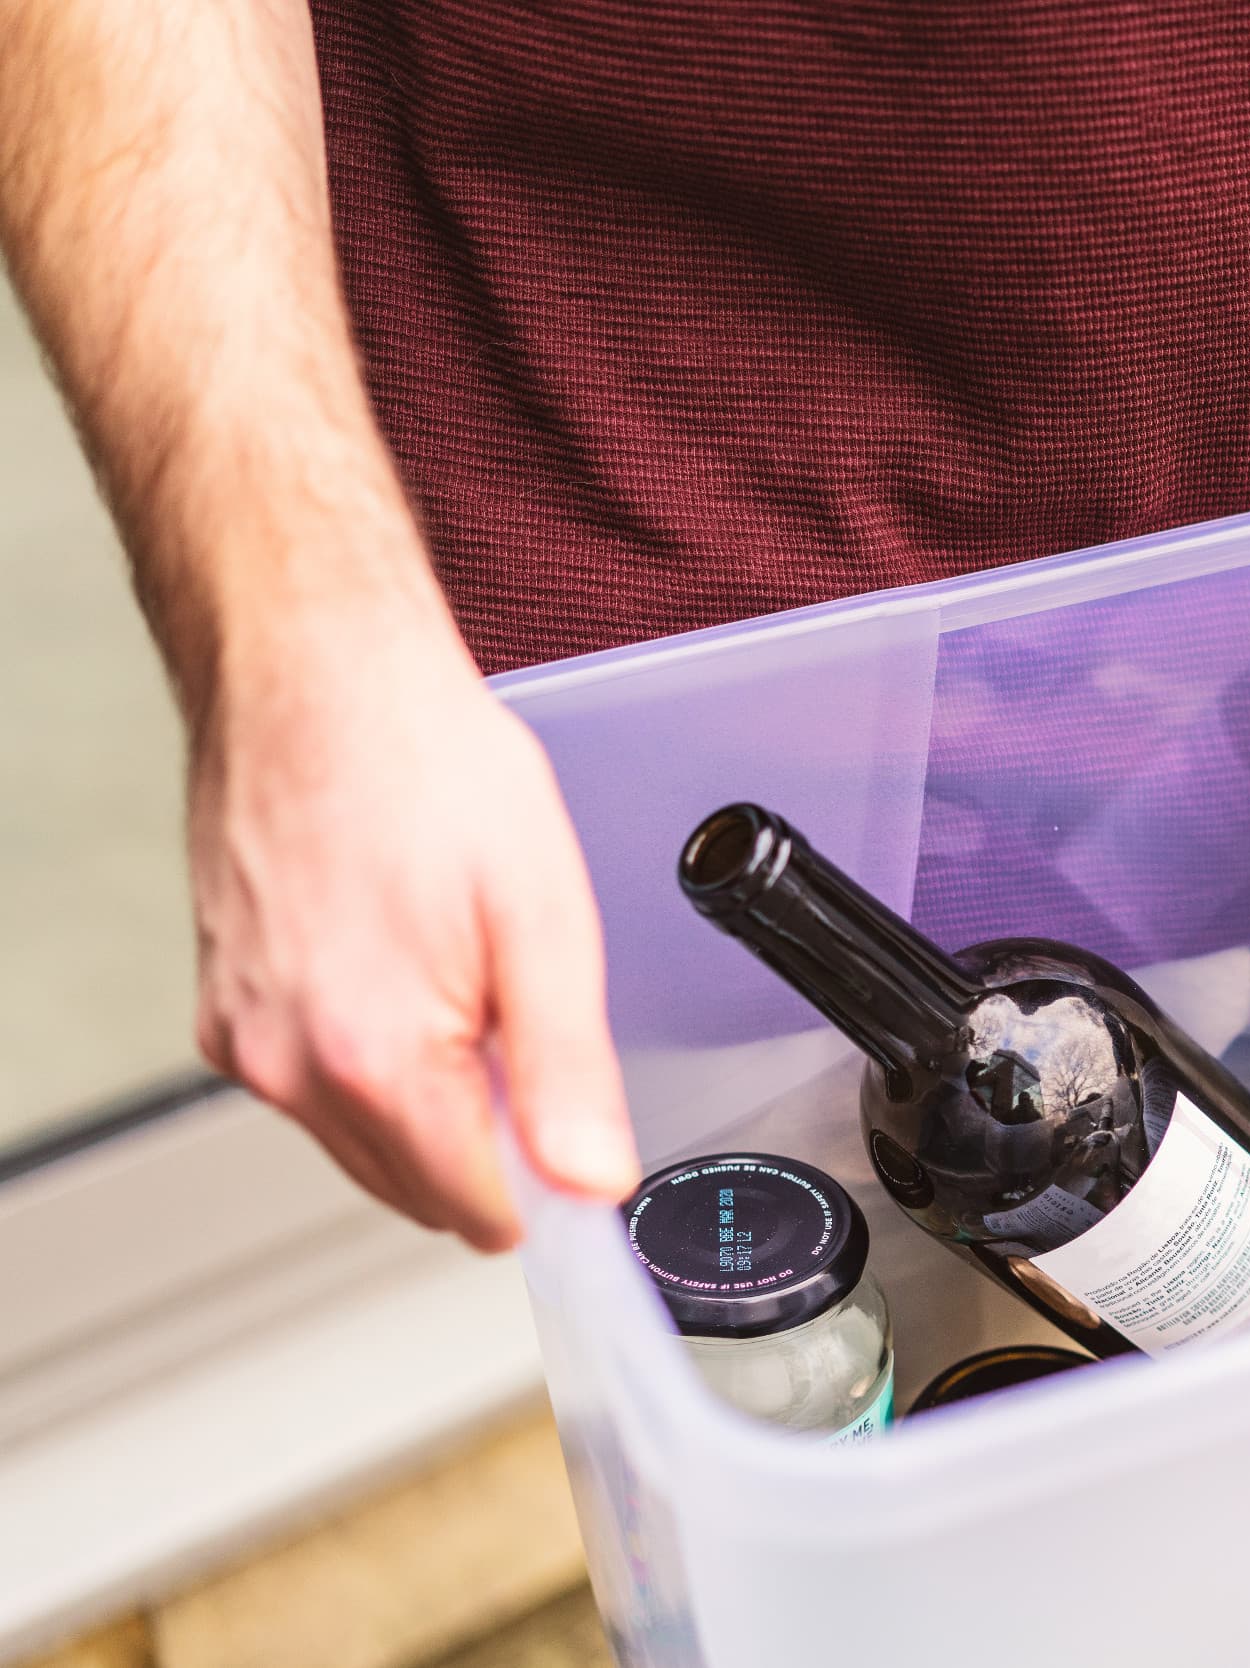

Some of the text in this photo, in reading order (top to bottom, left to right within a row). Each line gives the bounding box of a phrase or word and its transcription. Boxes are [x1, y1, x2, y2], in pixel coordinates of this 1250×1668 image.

[701, 1164, 740, 1175] PUSHED
[759, 1166, 779, 1175] CAN
[670, 1171, 699, 1185] DOWN
[780, 1171, 812, 1189] BUTTON
[719, 1188, 734, 1207] 2020
[810, 1188, 829, 1209] SAFETY
[633, 1196, 652, 1215] DOWN
[719, 1209, 734, 1224] MAR
[629, 1216, 639, 1241] PUSHED
[825, 1218, 833, 1230] USE
[736, 1231, 752, 1242] L2
[819, 1231, 831, 1245] NOT
[1158, 1229, 1180, 1253] Lisboa,
[631, 1242, 640, 1251] BE
[811, 1245, 823, 1256] DO
[1189, 1252, 1212, 1275] Touriga
[1213, 1218, 1234, 1249] Nacional
[635, 1251, 650, 1264] CAN
[648, 1263, 680, 1283] BUTTON
[779, 1269, 794, 1278] DO
[1163, 1270, 1186, 1289] Lisboa
[680, 1279, 717, 1290] SAFETY
[733, 1281, 753, 1289] USE
[757, 1275, 777, 1286] NOT
[1094, 1290, 1125, 1304] Nacional
[1135, 1266, 1163, 1286] Alicante
